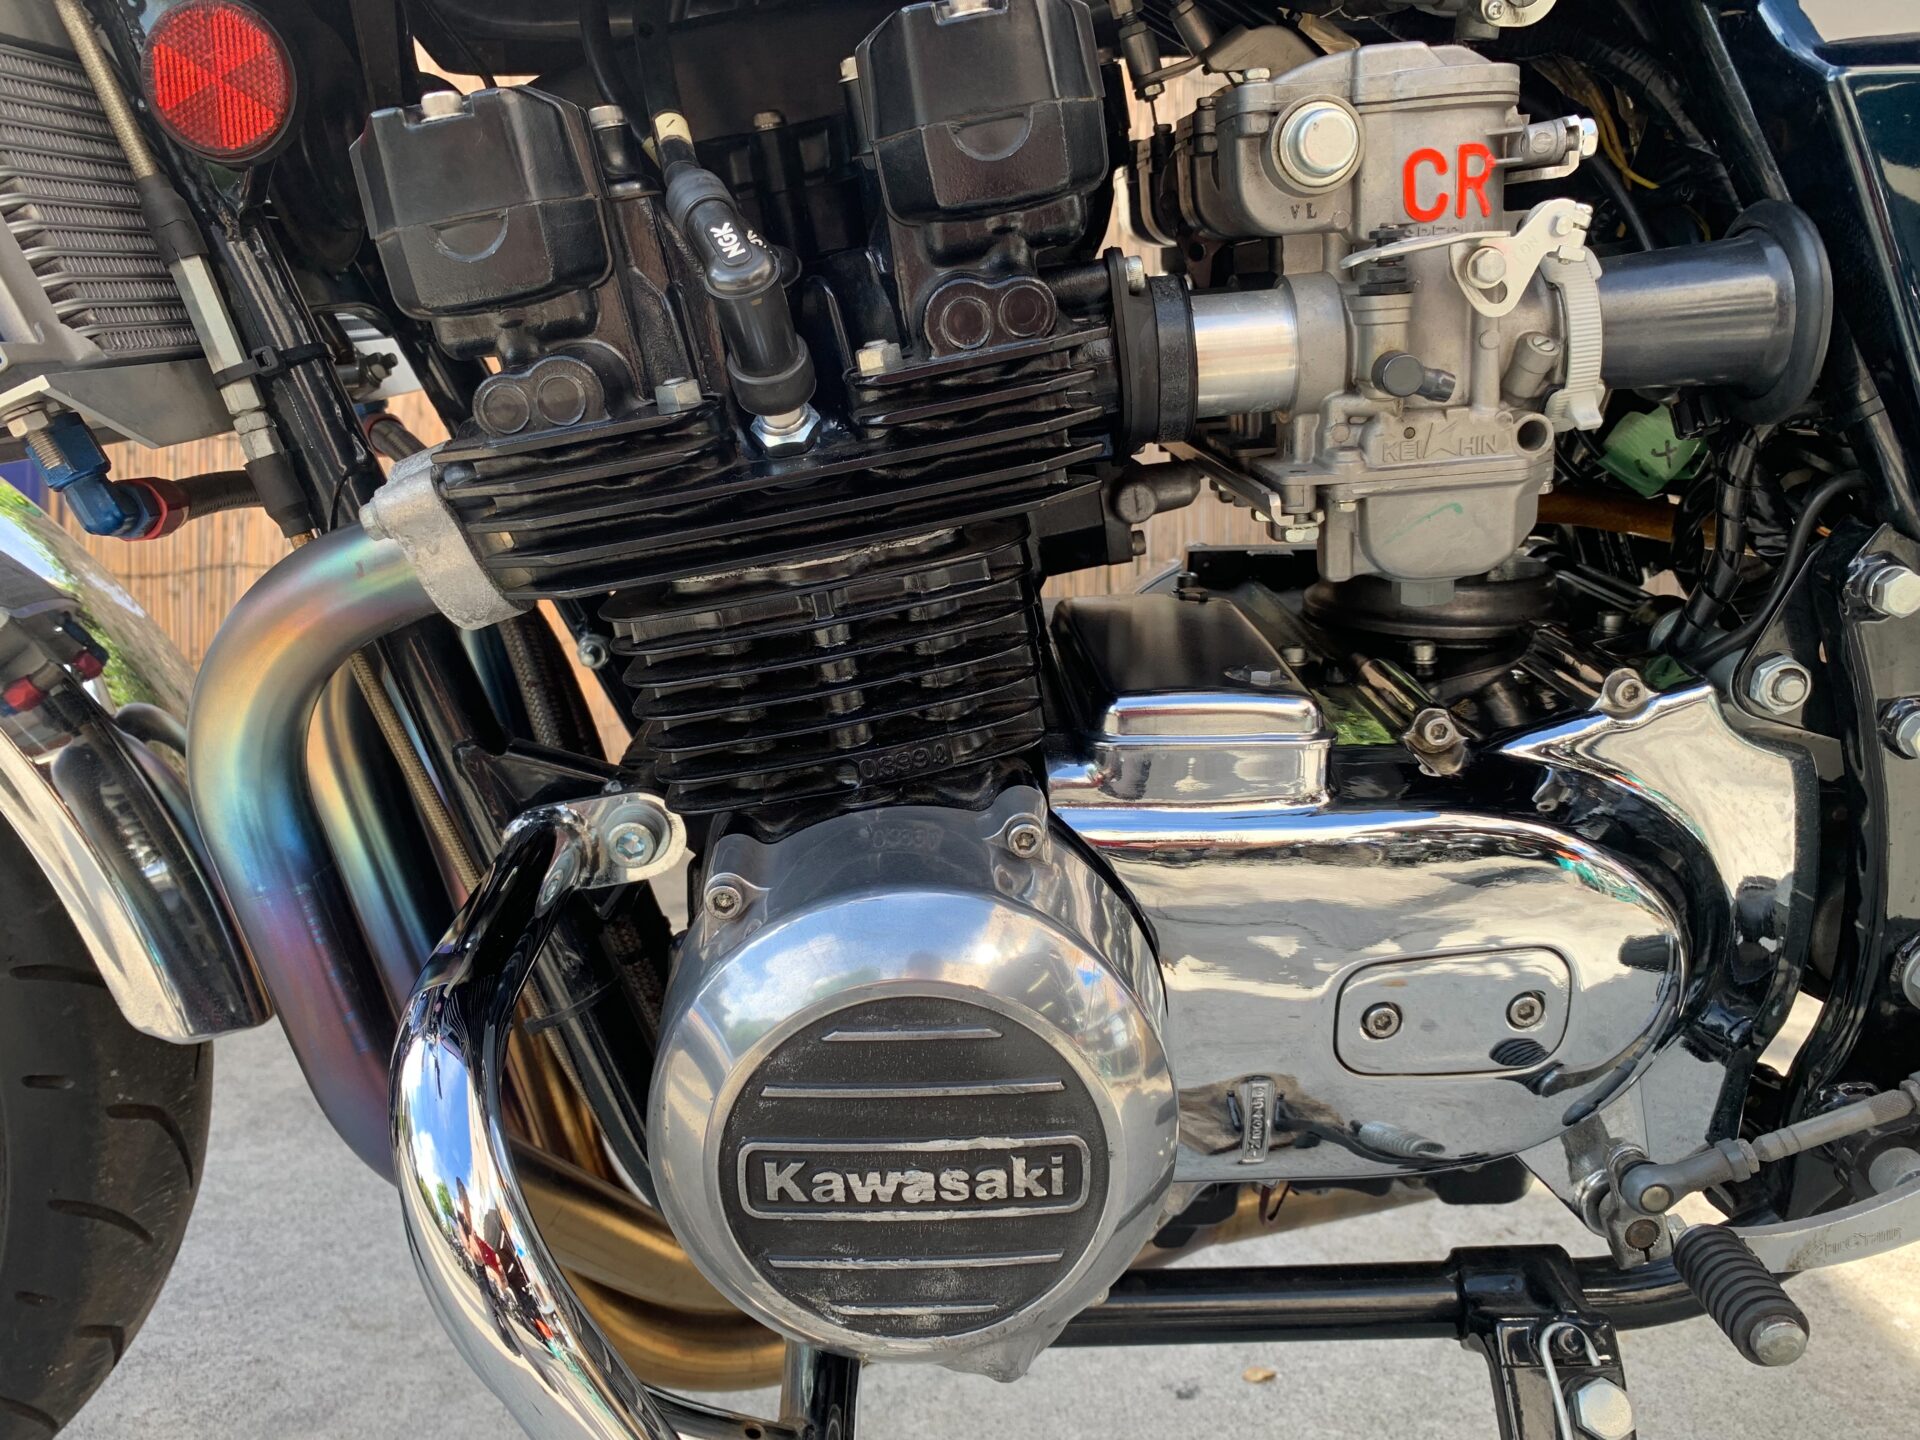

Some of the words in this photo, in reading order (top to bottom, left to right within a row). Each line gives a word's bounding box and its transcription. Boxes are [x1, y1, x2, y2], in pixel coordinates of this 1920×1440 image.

[1403, 143, 1494, 223] CR
[709, 222, 746, 259] NGK
[763, 1154, 1064, 1204] Kawasaki
